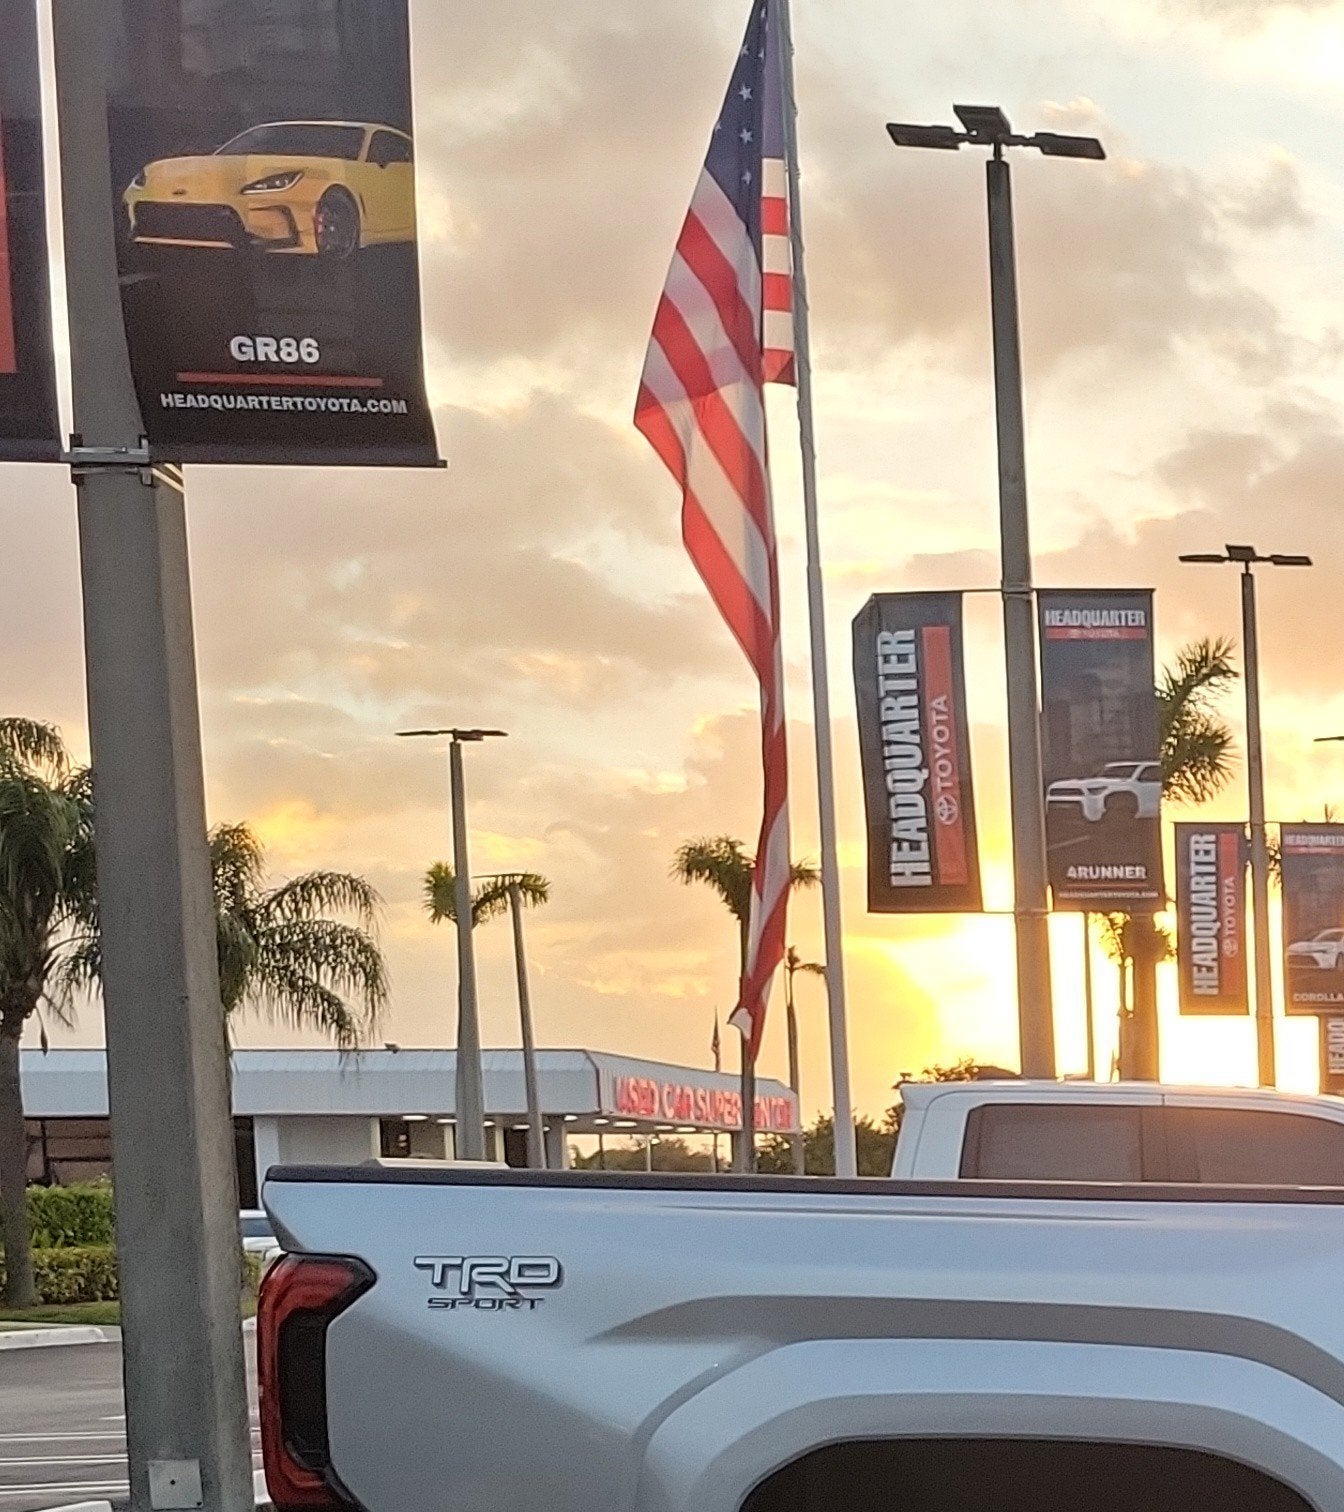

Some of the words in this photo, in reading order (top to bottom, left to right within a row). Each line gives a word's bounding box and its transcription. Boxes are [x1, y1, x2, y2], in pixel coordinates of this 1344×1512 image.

[230, 336, 320, 363] GR86
[161, 393, 408, 414] HEADQUARTERTOYOTA.COM
[1045, 609, 1146, 629] HEADQUARTER
[878, 629, 932, 887] HEADQUARTER
[930, 695, 959, 788] TOYOTA
[1067, 866, 1147, 879] 4RUNNER
[1190, 833, 1221, 995] HEADQUARTER
[1223, 877, 1238, 939] TOYOTA
[616, 1076, 659, 1116] USED
[662, 1082, 695, 1121] CAR
[414, 1256, 563, 1294] TRD
[428, 1297, 545, 1311] SPORT
